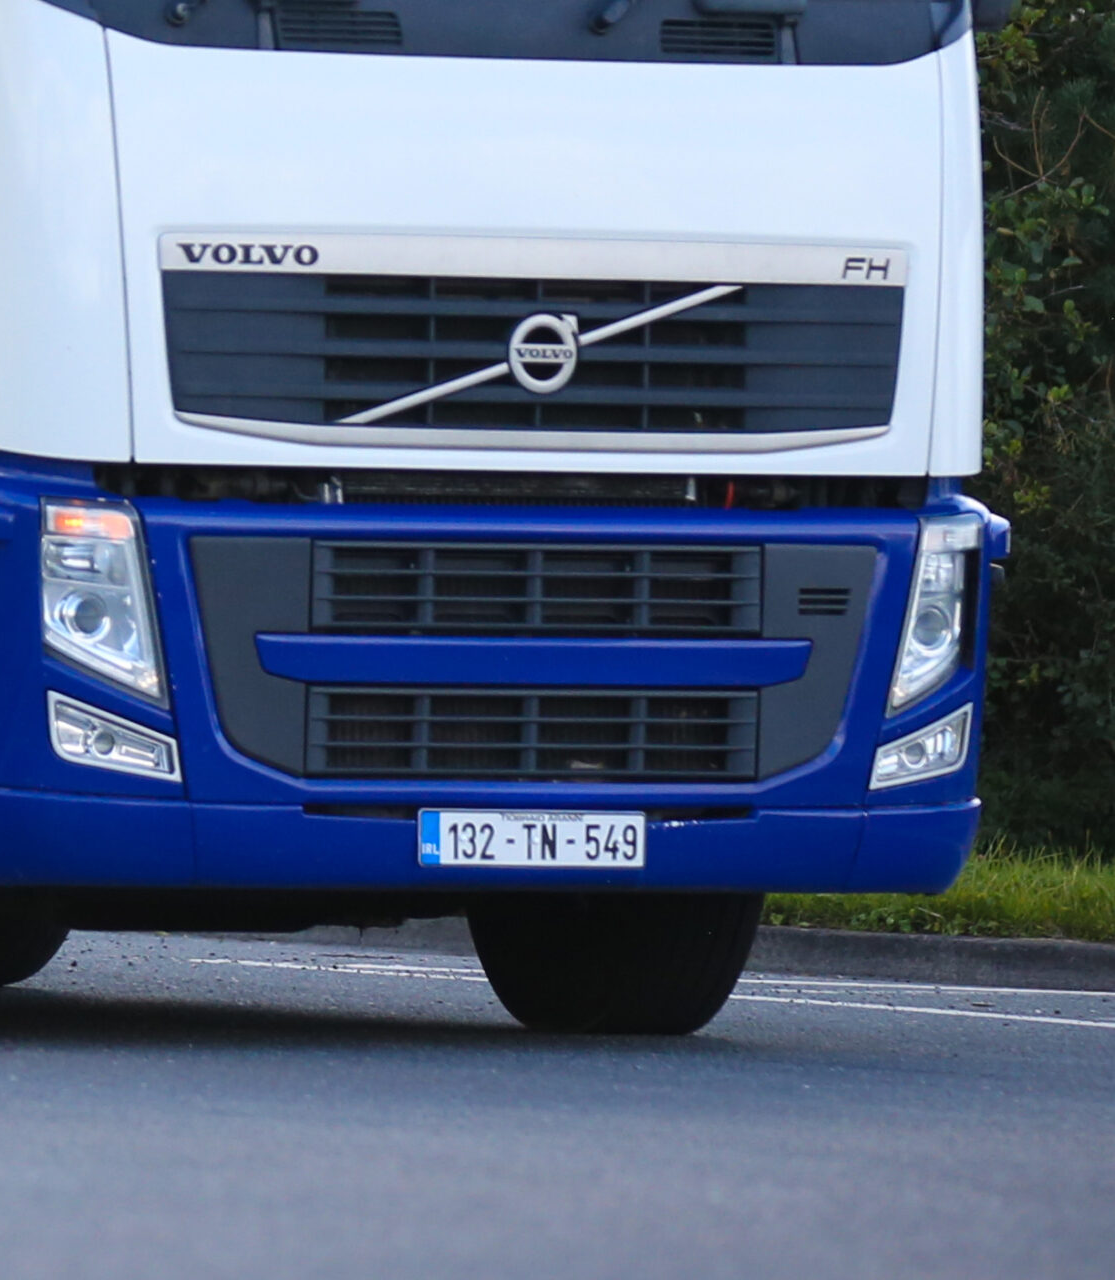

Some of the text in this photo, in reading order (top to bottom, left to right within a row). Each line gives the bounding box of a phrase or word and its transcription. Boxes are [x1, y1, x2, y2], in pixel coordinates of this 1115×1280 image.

[176, 242, 319, 266] VOLVO
[841, 257, 891, 280] FH
[514, 347, 575, 361] VOLVO
[421, 842, 440, 855] IRL
